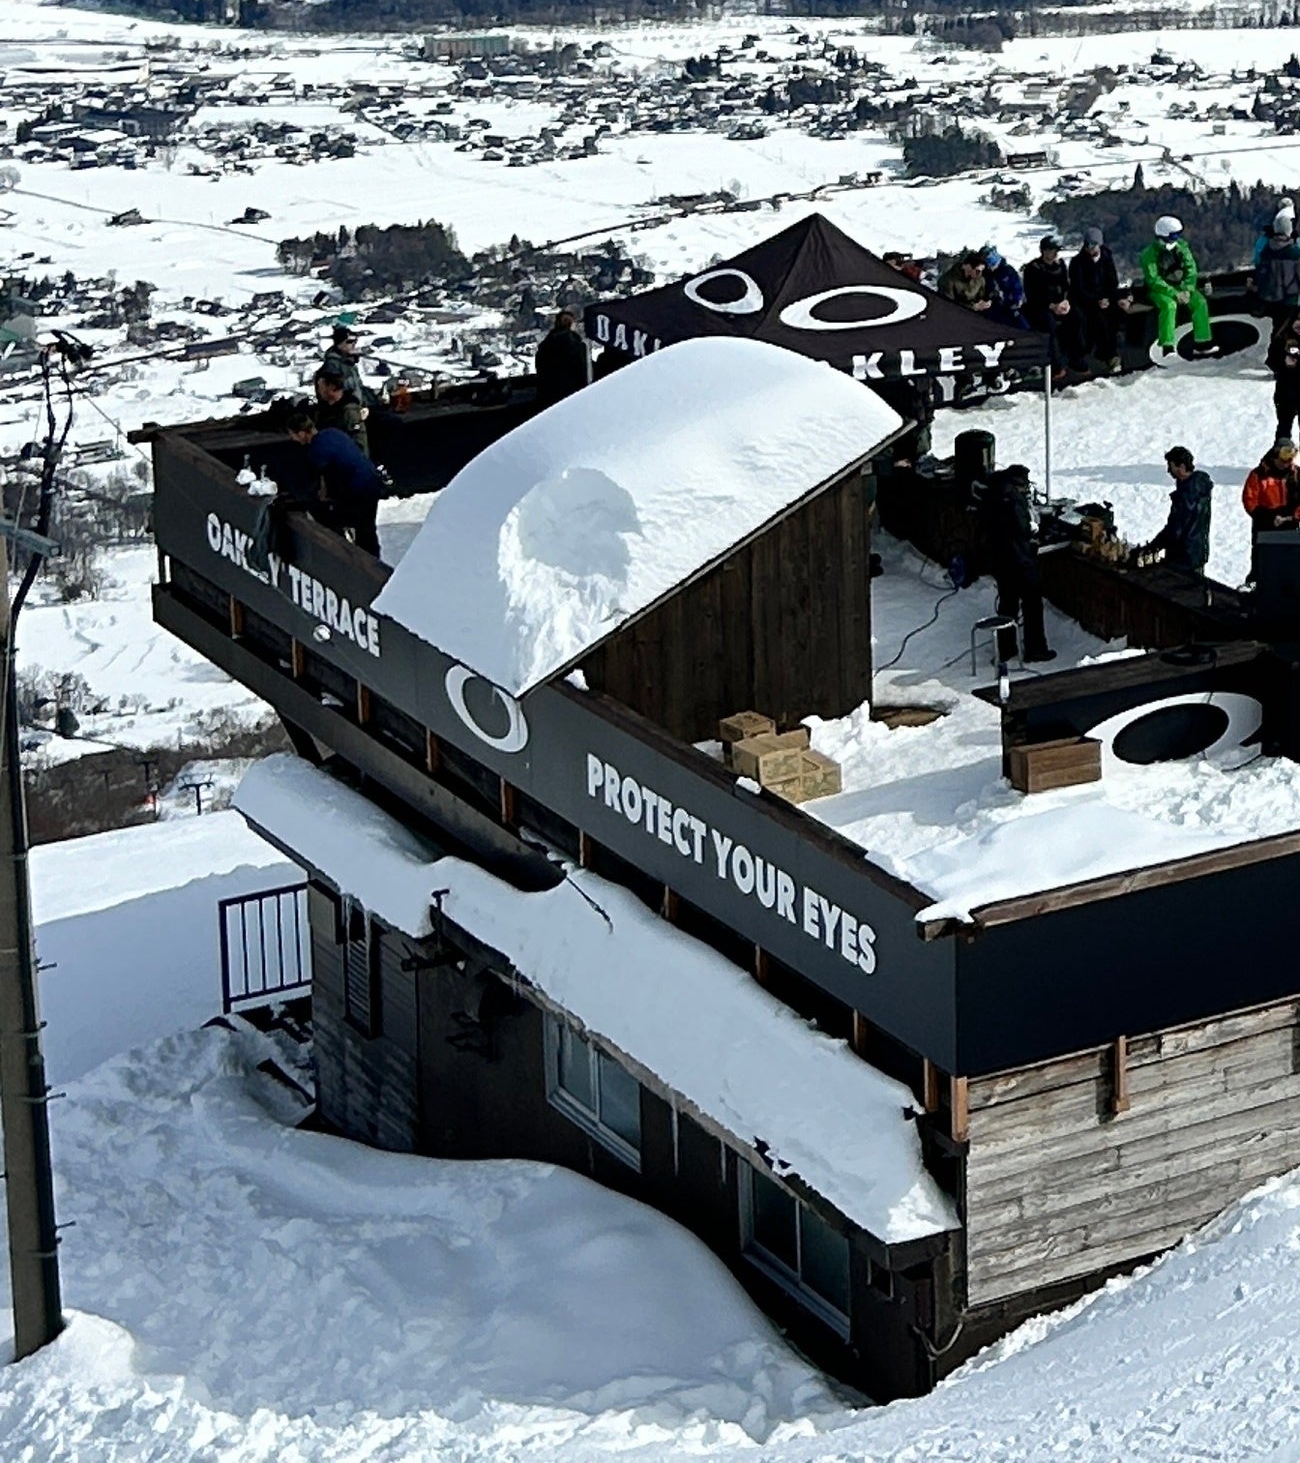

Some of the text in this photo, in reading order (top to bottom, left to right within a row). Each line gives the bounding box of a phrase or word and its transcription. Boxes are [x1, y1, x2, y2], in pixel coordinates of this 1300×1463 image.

[852, 341, 1006, 380] KLEY
[207, 512, 380, 657] OAKY TERRACE
[587, 753, 877, 974] PROTECT YOUR EYES
